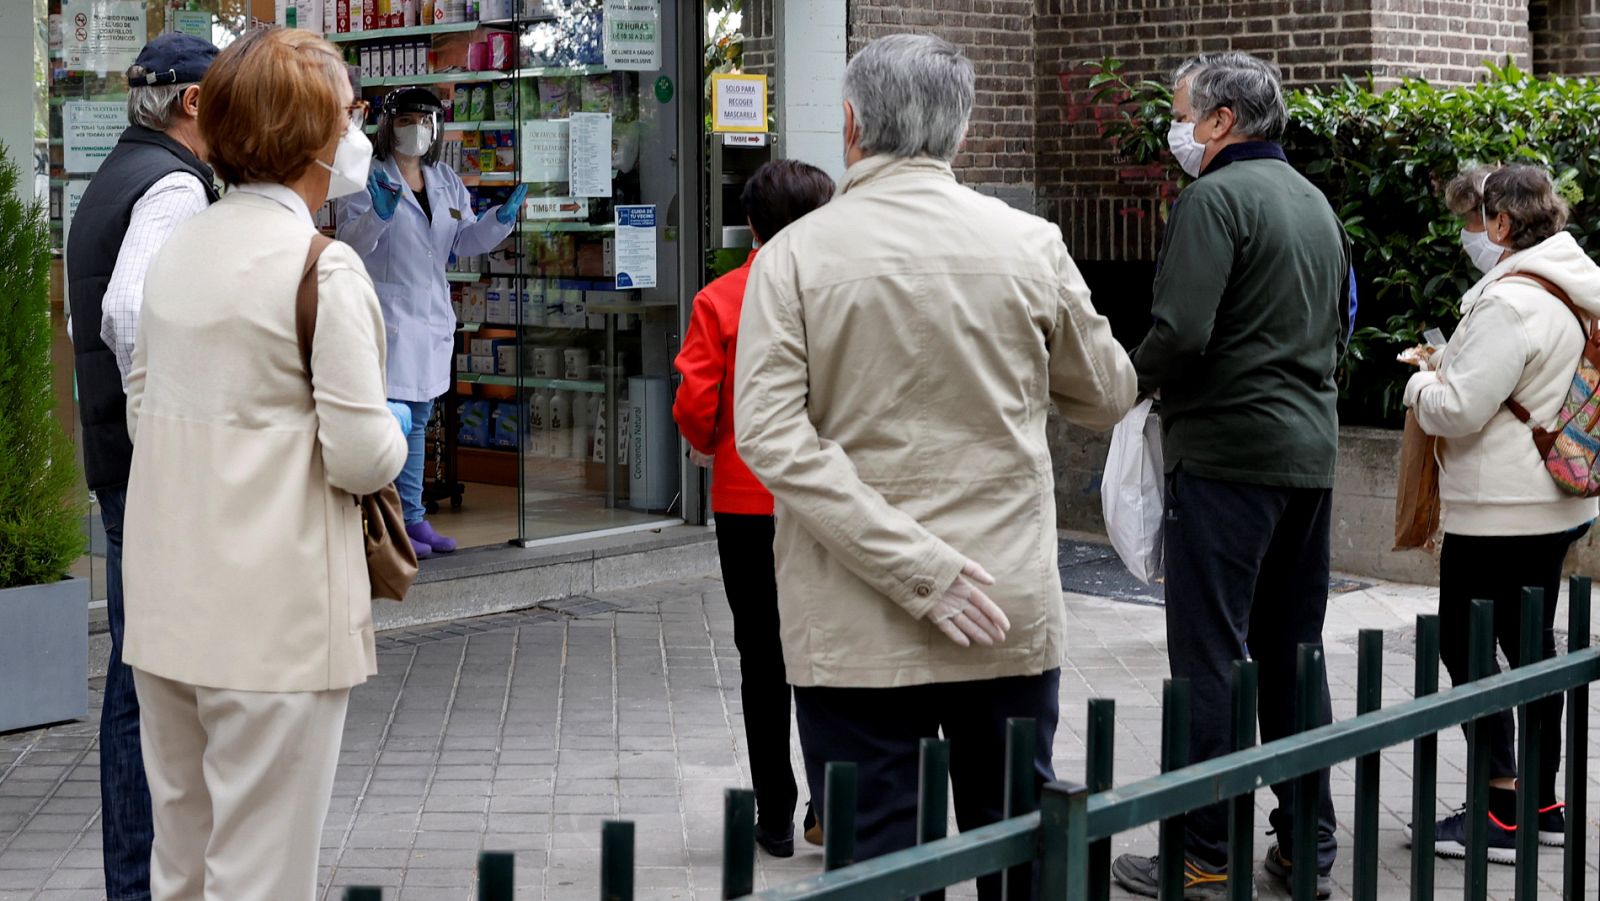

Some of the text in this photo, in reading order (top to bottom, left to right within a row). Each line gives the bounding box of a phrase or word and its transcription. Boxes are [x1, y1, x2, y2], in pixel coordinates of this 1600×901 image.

[728, 98, 753, 106] RECOGER
[723, 111, 757, 119] MASCARILLA
[532, 203, 557, 214] TIMBRE
[633, 406, 642, 480] Conciencia Natural
